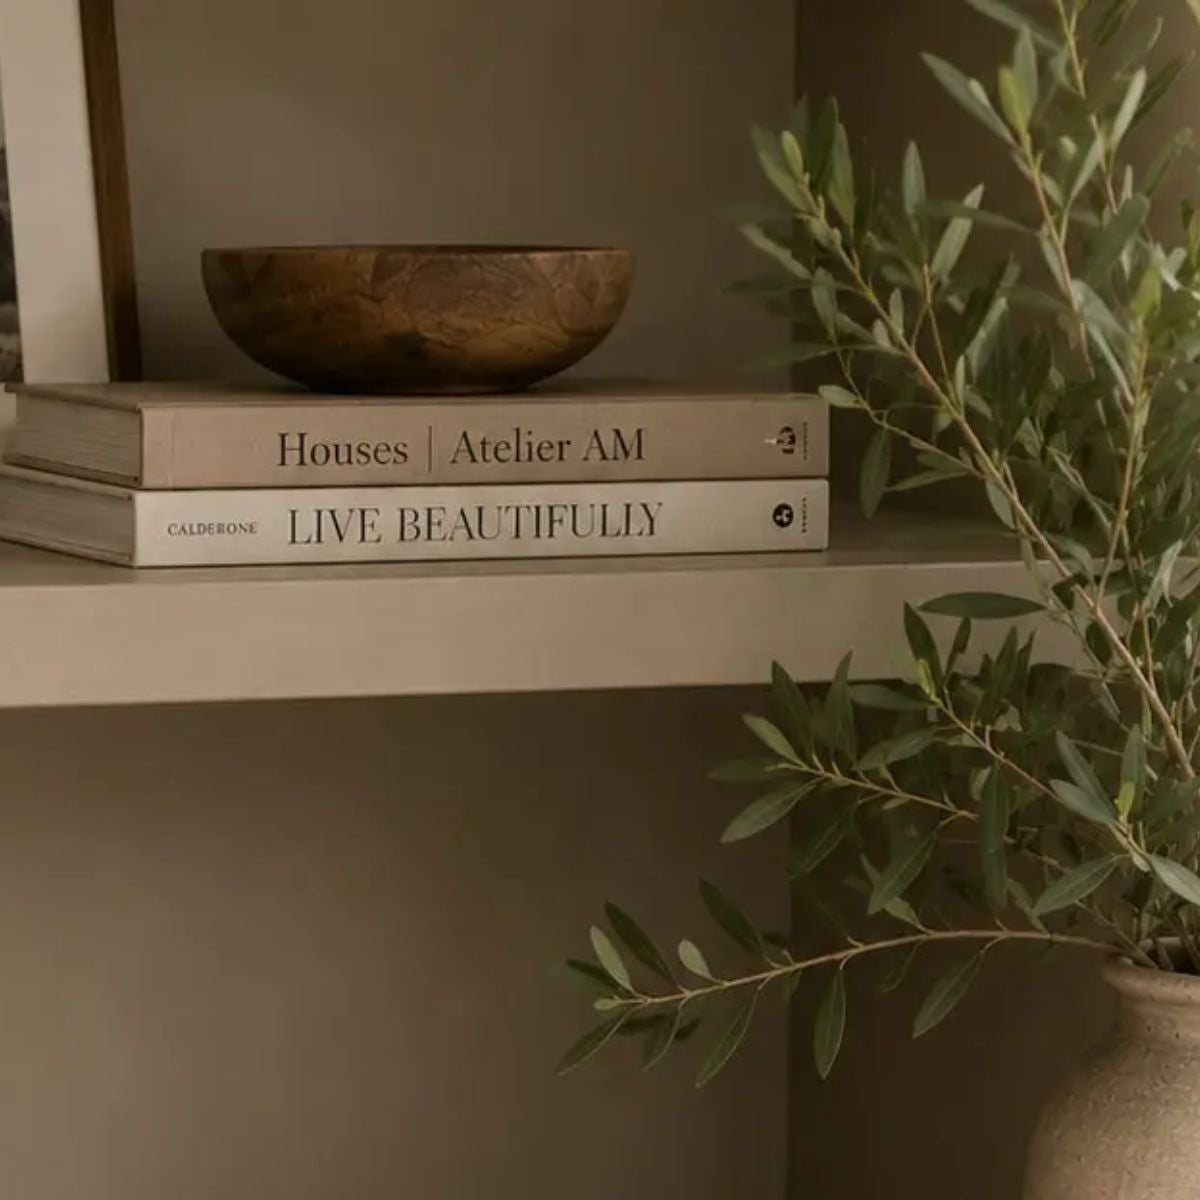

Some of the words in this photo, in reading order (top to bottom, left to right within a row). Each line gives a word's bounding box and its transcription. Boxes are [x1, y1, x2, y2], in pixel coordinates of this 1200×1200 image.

[278, 433, 408, 466] Houses
[450, 427, 571, 464] Atelier
[583, 428, 643, 461] AM
[167, 522, 257, 536] CALDERONE
[290, 508, 381, 544] LIVE
[399, 503, 662, 542] BEAUTIFULLY
